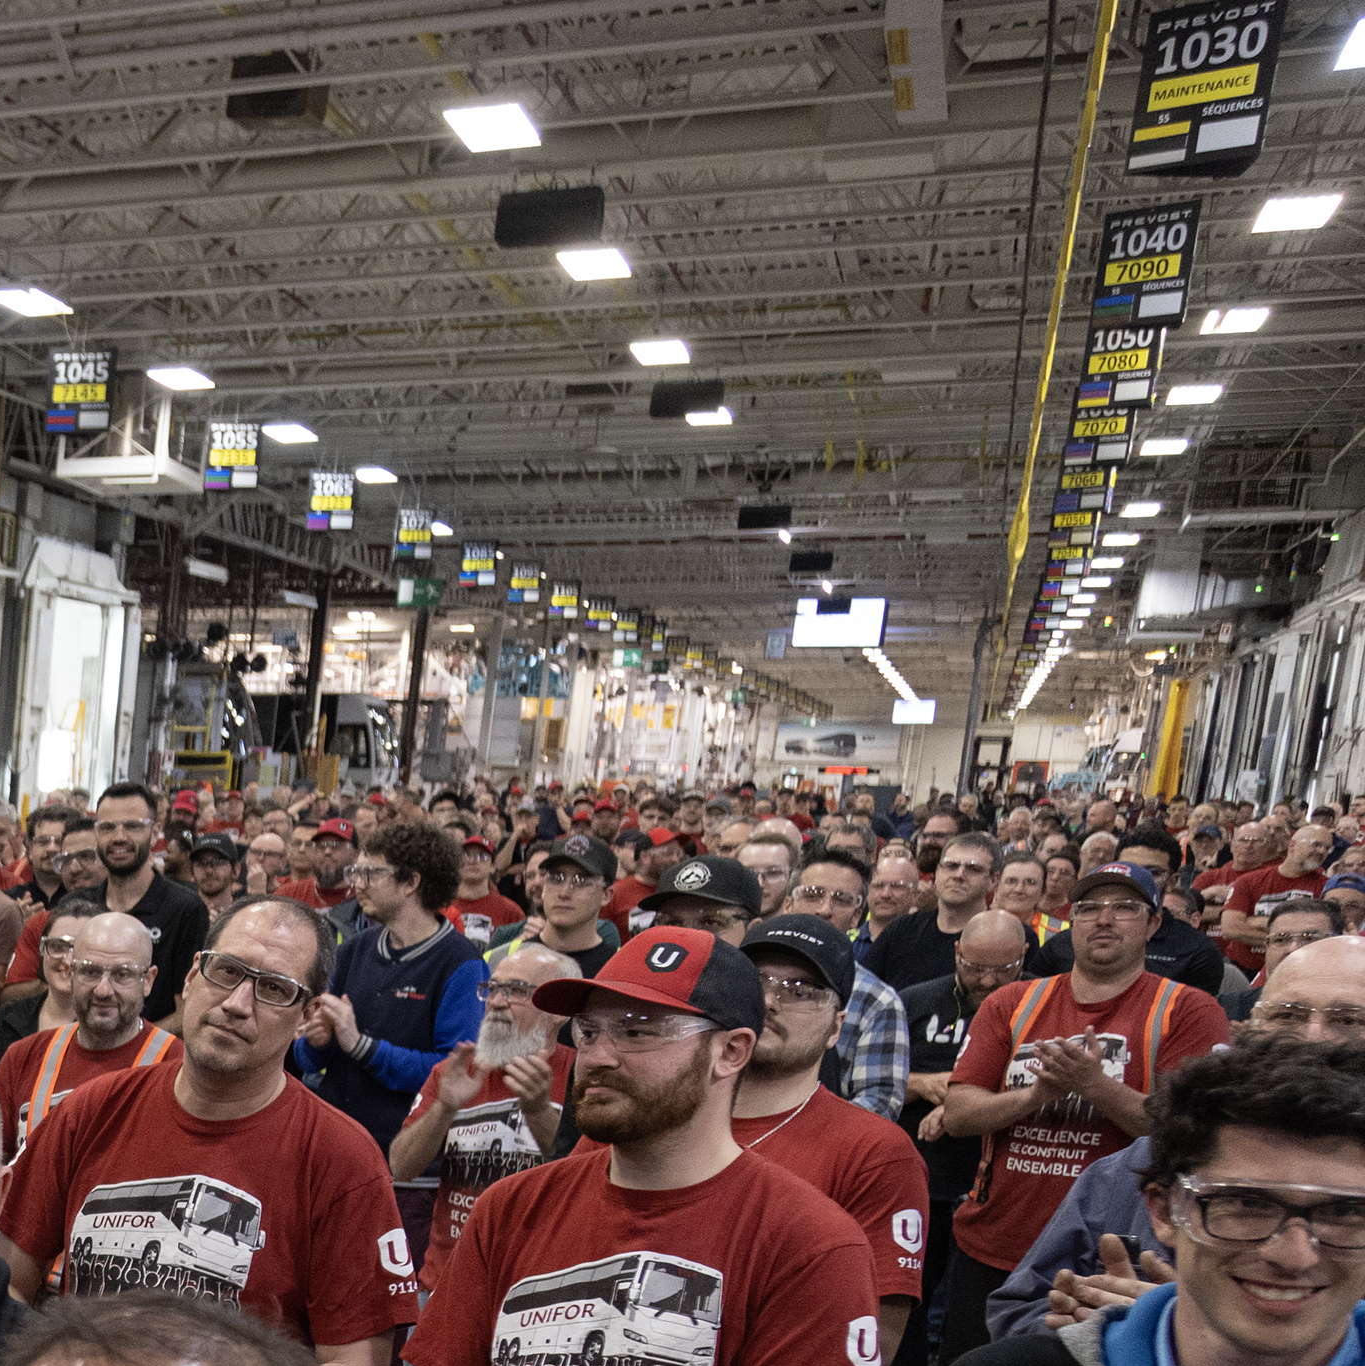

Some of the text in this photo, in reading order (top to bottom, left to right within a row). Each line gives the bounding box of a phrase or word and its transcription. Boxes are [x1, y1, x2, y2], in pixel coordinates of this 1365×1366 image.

[1156, 1, 1277, 34] PREVOST
[1154, 20, 1268, 75] 1030
[1154, 75, 1251, 101] MAINTENANCE
[1201, 98, 1264, 117] SÉQUENCES
[1109, 223, 1187, 260] 1040
[1116, 258, 1169, 283] 7090
[1092, 329, 1154, 352] 1050
[1098, 353, 1139, 371] 7080
[54, 362, 109, 384] 1045
[1081, 420, 1118, 436] 7070
[211, 431, 258, 449] 1055
[313, 480, 354, 496] 1065
[767, 930, 824, 946] PREVOST
[456, 1124, 497, 1137] UNIFOR
[1009, 1142, 1088, 1160] SE CONSTRUIT
[1006, 1157, 1082, 1178] ENSEMBLE
[91, 1213, 156, 1231] UNIFOR
[520, 1303, 596, 1328] UNIFOR
